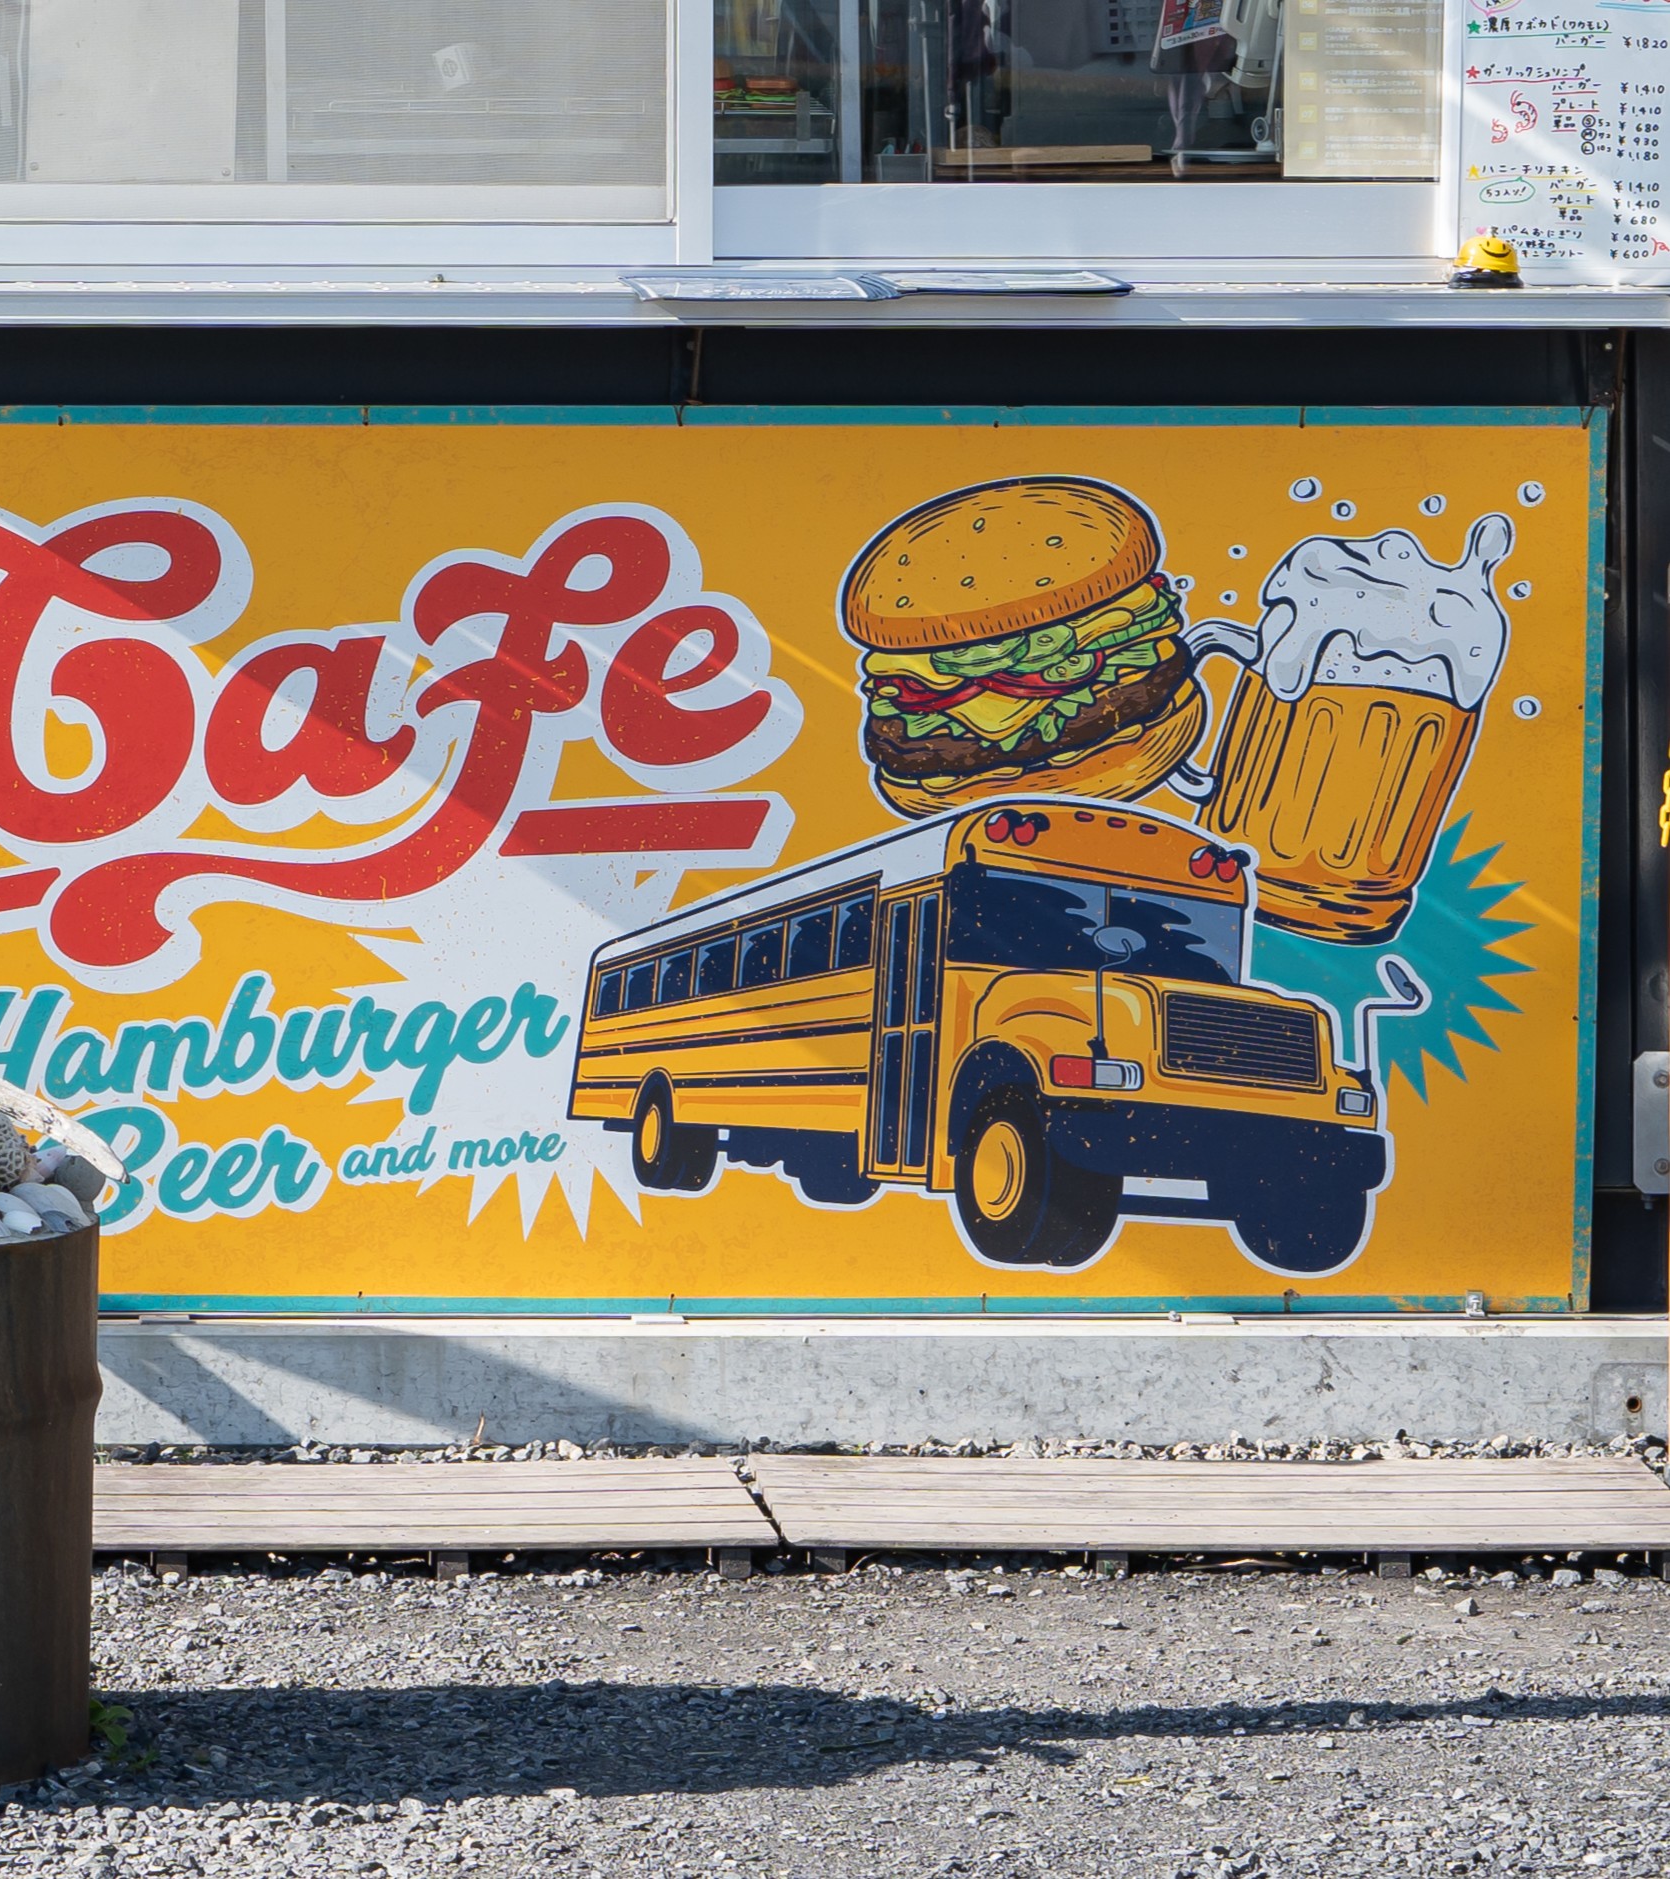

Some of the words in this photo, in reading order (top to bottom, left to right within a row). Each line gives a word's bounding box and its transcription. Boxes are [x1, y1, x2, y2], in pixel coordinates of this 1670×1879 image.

[1483, 16, 1510, 33] 濃厚
[1555, 34, 1606, 48] バーガー
[1552, 78, 1602, 91] バーガー
[1552, 98, 1599, 111] プレート
[1549, 194, 1595, 205] プレート
[342, 1126, 438, 1180] and
[447, 1130, 568, 1171] more
